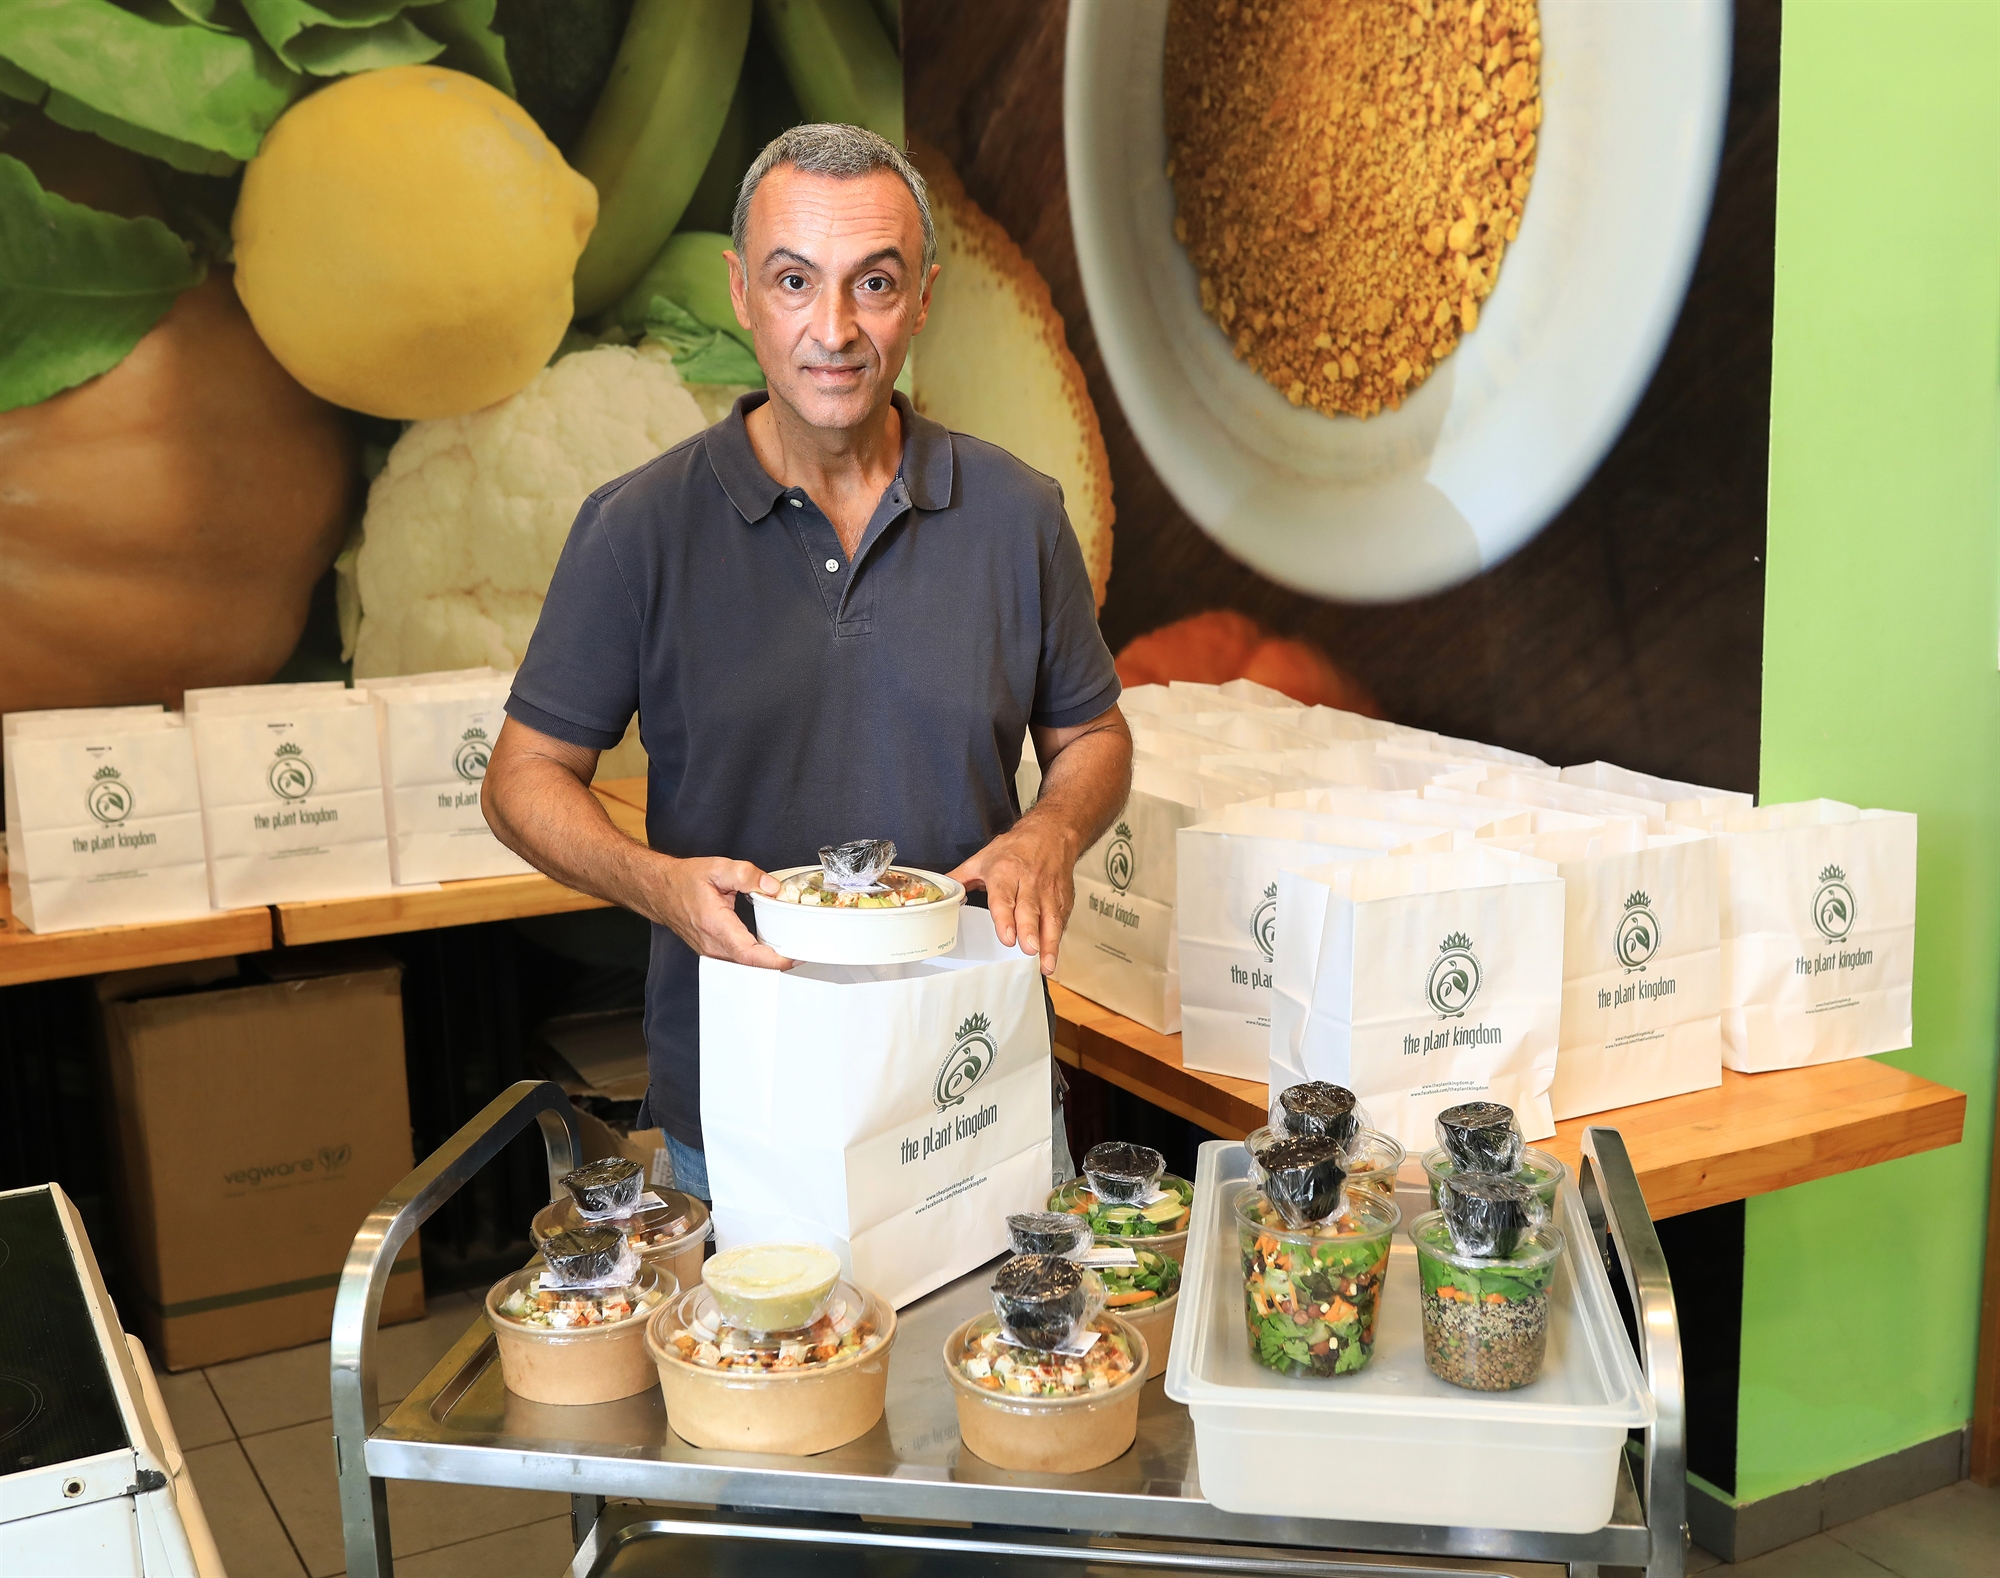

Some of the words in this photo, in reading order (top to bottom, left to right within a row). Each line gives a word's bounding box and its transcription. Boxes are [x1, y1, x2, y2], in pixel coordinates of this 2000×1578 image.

[438, 793, 452, 808] the
[455, 791, 478, 809] plant
[254, 814, 270, 830] the
[272, 811, 296, 830] plant
[299, 807, 338, 826] kingdom
[73, 837, 88, 853] the
[91, 835, 115, 854] plant
[118, 830, 157, 849] kingdom
[1089, 892, 1099, 912] the
[1099, 897, 1115, 918] plant
[1115, 902, 1140, 929] kingdom
[1230, 964, 1248, 985] the
[1795, 956, 1812, 975] the
[1814, 953, 1836, 977] plant
[1838, 947, 1873, 970] kingdom
[1598, 988, 1611, 1009] the
[1614, 982, 1636, 1009] plant
[1638, 976, 1676, 1001] kingdom
[1403, 1033, 1420, 1056] the
[1423, 1029, 1450, 1057] plant
[1453, 1022, 1502, 1049] kingdom
[941, 1043, 957, 1067] HEALTHY
[1410, 1086, 1489, 1097] www.facebook.com/theplantkingdom
[1422, 1080, 1475, 1089] www.theplantkingdom.gr
[900, 1137, 919, 1165] the
[923, 1122, 952, 1160] plant
[955, 1103, 998, 1141] kingdom
[224, 1158, 314, 1186] vegware
[914, 1176, 988, 1215] www.facebook.com/theplantkingdom
[926, 1174, 975, 1201] www.theplantkingdom.gr
